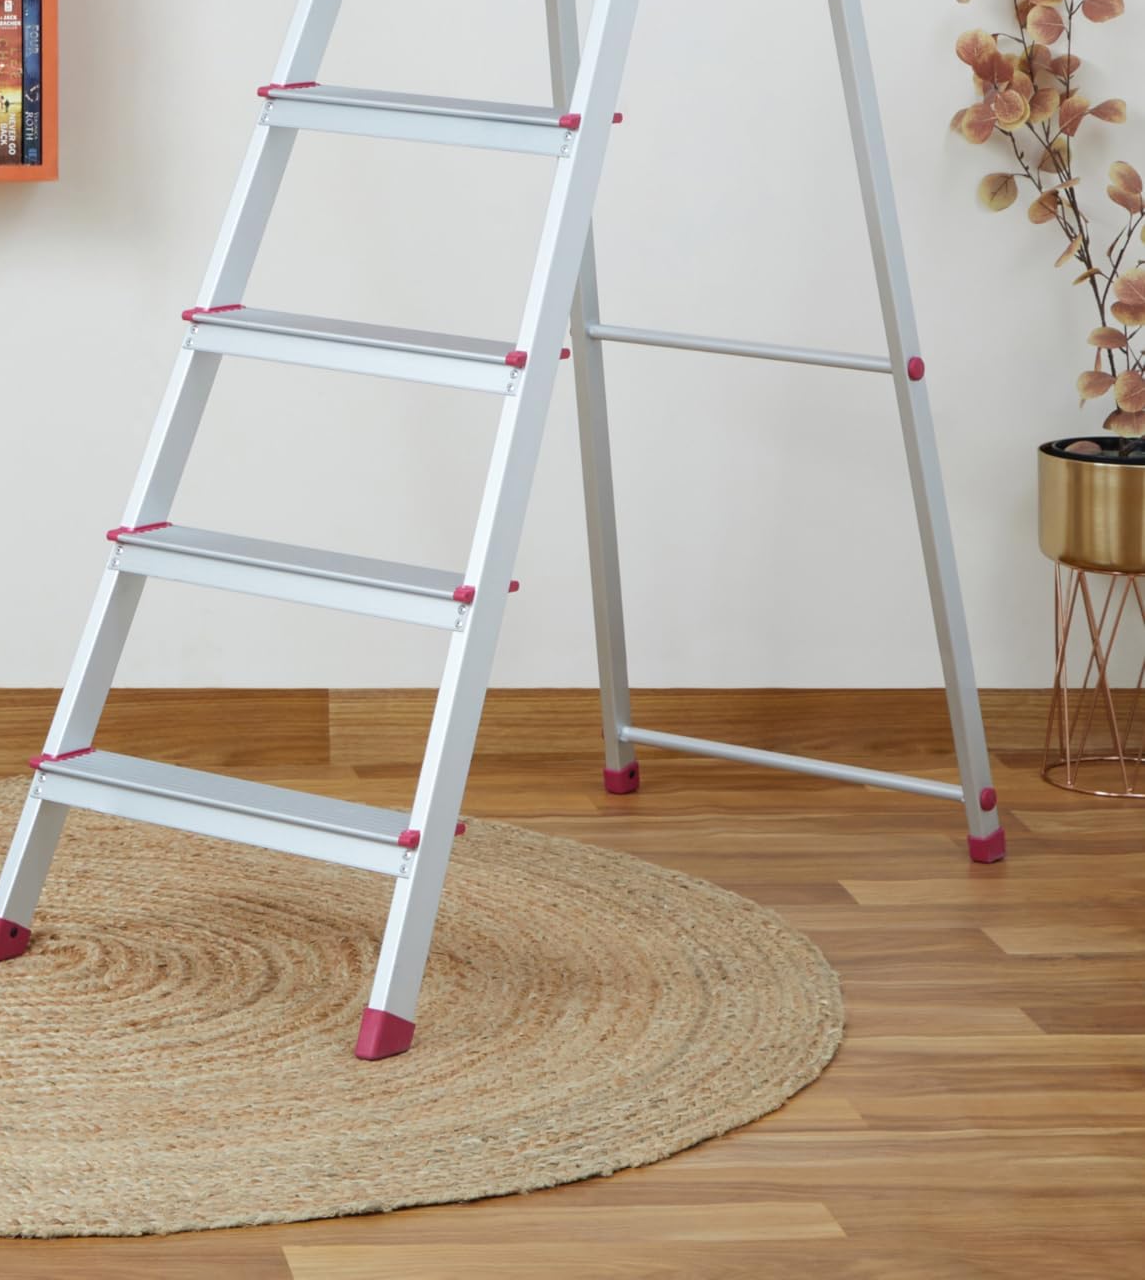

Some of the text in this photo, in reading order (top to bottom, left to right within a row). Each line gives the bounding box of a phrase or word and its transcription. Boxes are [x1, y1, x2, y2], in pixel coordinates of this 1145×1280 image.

[29, 24, 40, 55] FOUR
[0, 122, 8, 145] BACK
[8, 113, 16, 155] NEVER GO
[25, 111, 35, 140] ROTH
